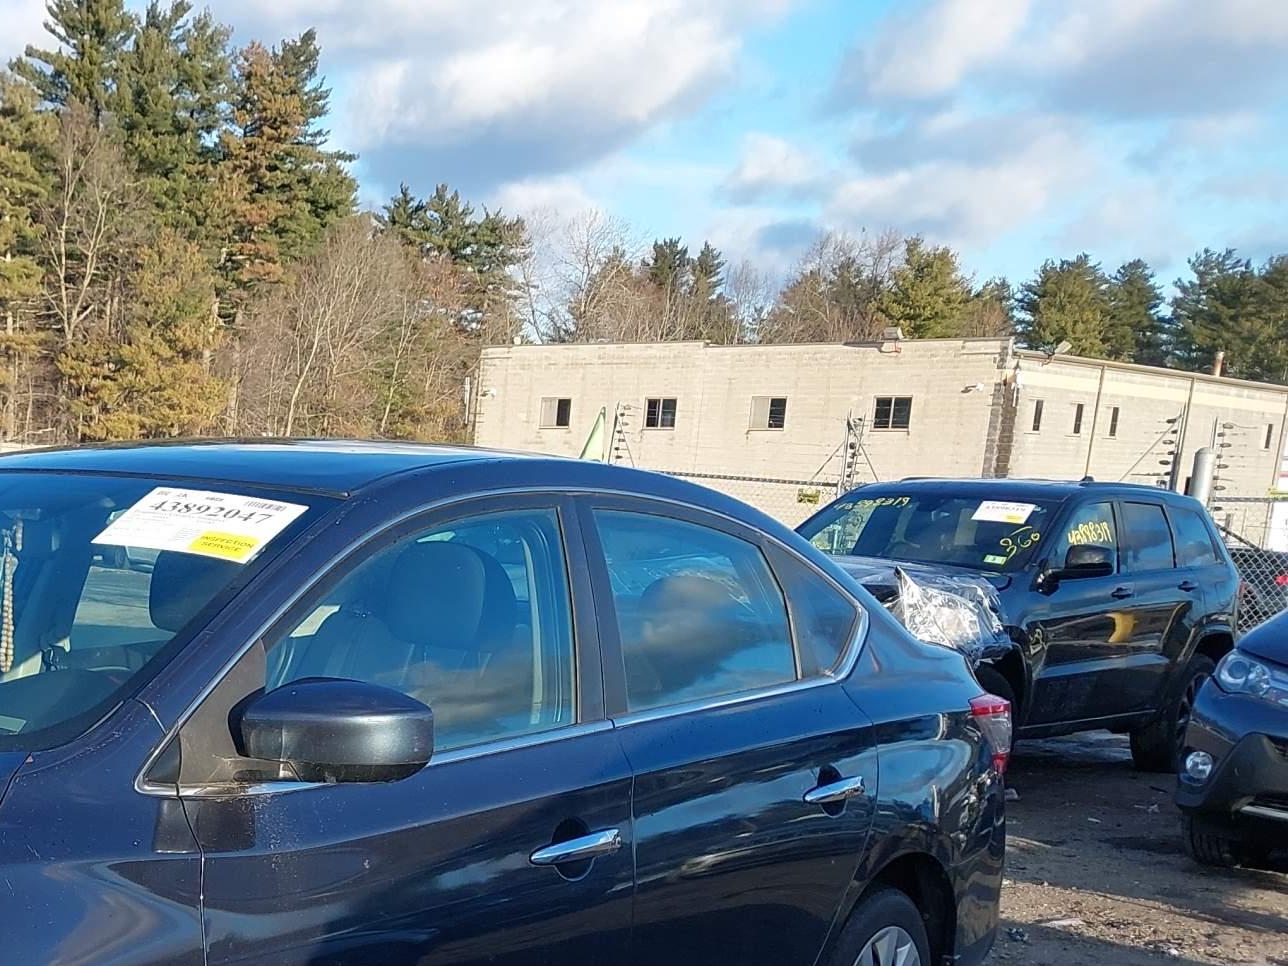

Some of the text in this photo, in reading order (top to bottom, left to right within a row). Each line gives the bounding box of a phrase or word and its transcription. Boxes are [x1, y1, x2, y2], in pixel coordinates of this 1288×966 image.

[149, 500, 273, 524] 43892047
[200, 535, 254, 549] INSPECTION
[201, 541, 242, 552] SERVICE
